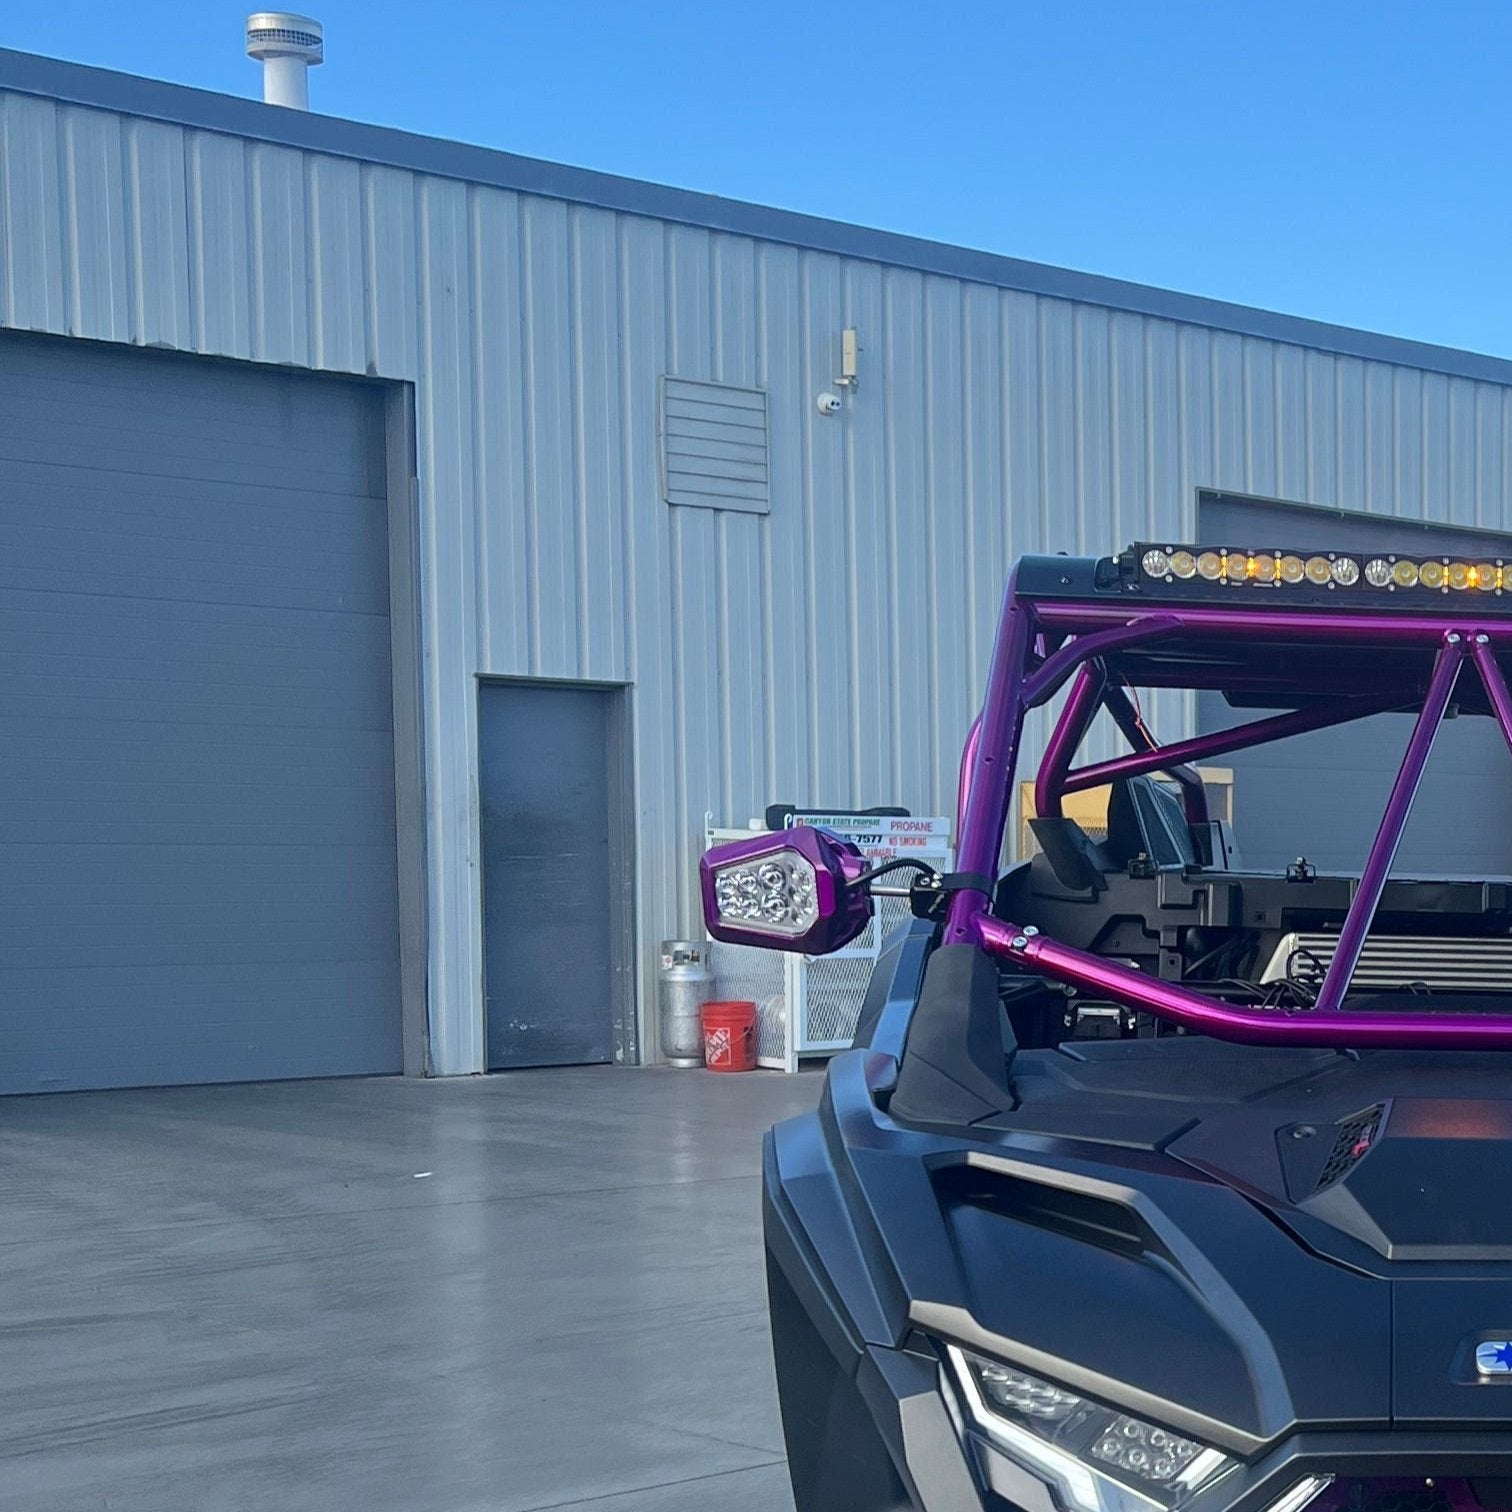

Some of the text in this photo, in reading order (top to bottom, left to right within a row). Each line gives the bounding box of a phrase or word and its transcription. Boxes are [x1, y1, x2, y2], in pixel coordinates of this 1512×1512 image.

[833, 817, 851, 825] STATE
[890, 820, 933, 833] PROPANE
[889, 836, 928, 848] NO SMOKING
[860, 847, 897, 858] LAMMABLE
